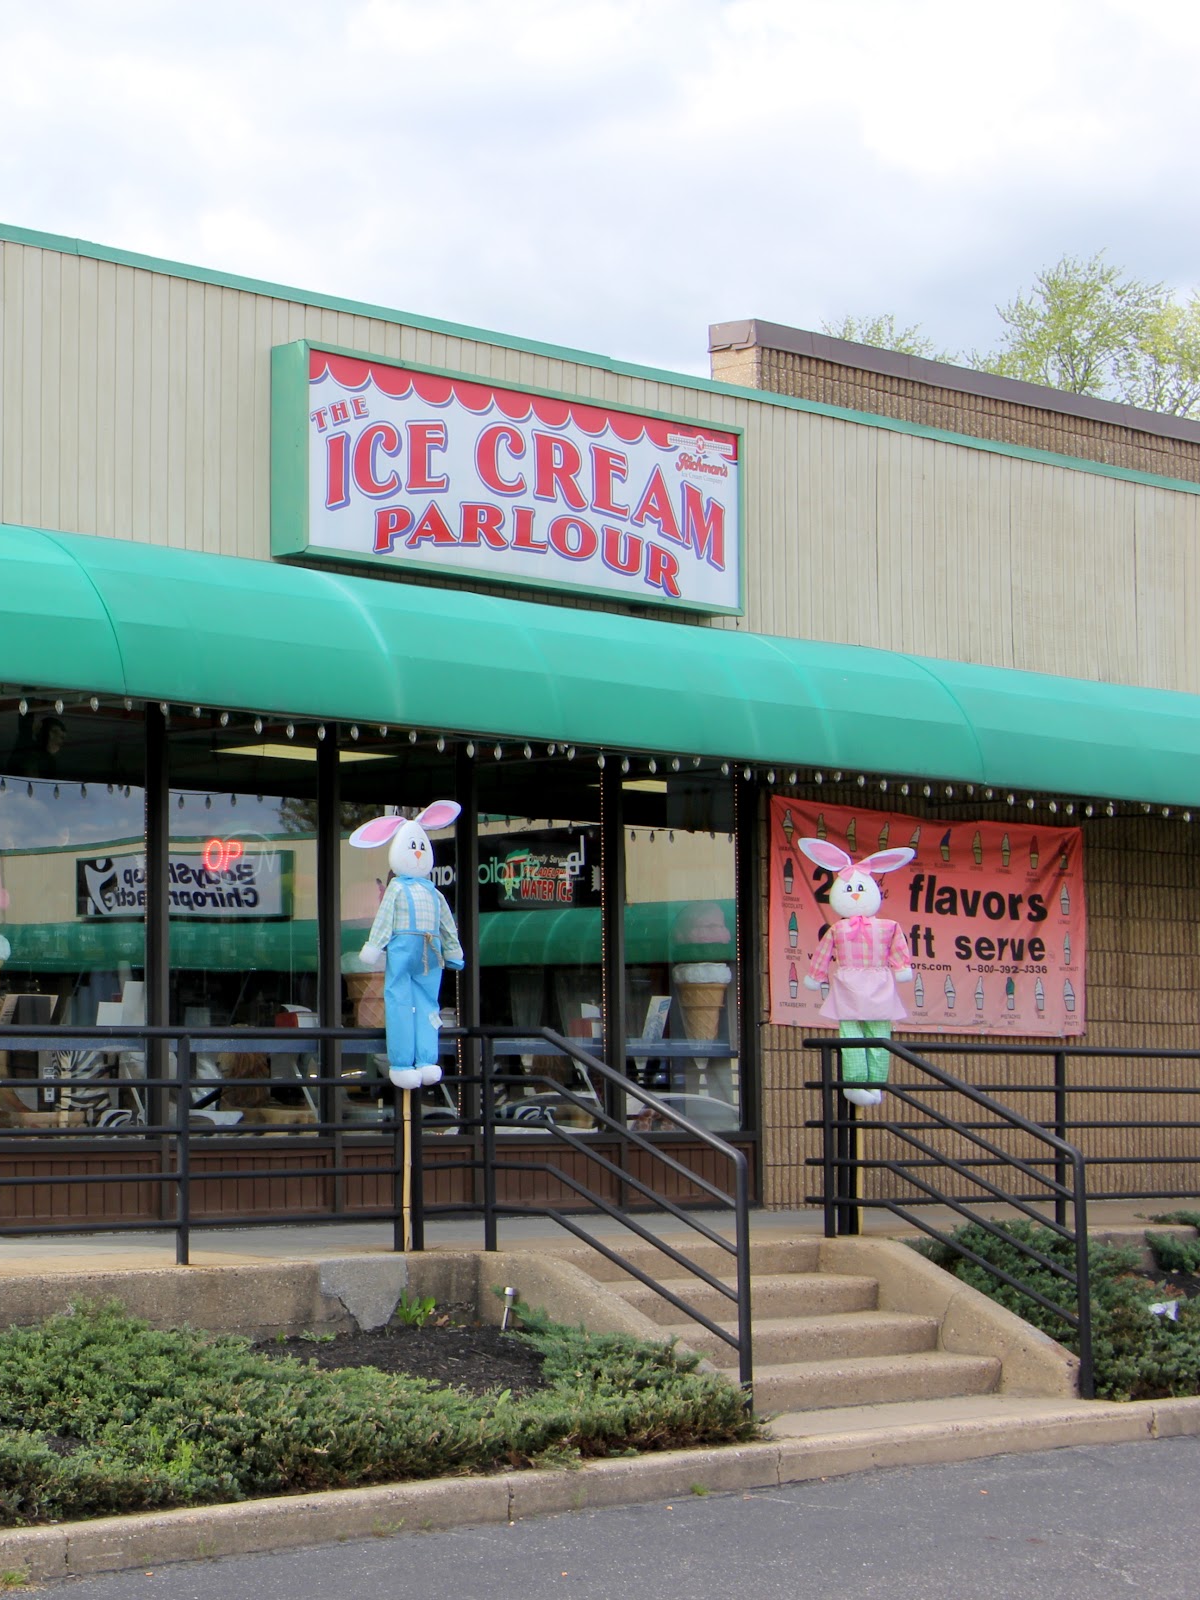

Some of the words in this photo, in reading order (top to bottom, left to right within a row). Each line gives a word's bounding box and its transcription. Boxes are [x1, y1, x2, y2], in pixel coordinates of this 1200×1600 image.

[311, 396, 369, 432] THE
[675, 452, 728, 478] Richman's
[325, 419, 451, 511] ICE
[474, 422, 726, 571] CREAM
[373, 500, 682, 598] PARLOUR
[550, 855, 568, 863] Servin
[521, 879, 555, 901] WATER
[556, 880, 573, 902] ICE
[909, 874, 1048, 922] flavors
[906, 924, 935, 959] ft
[955, 935, 1046, 962] serve
